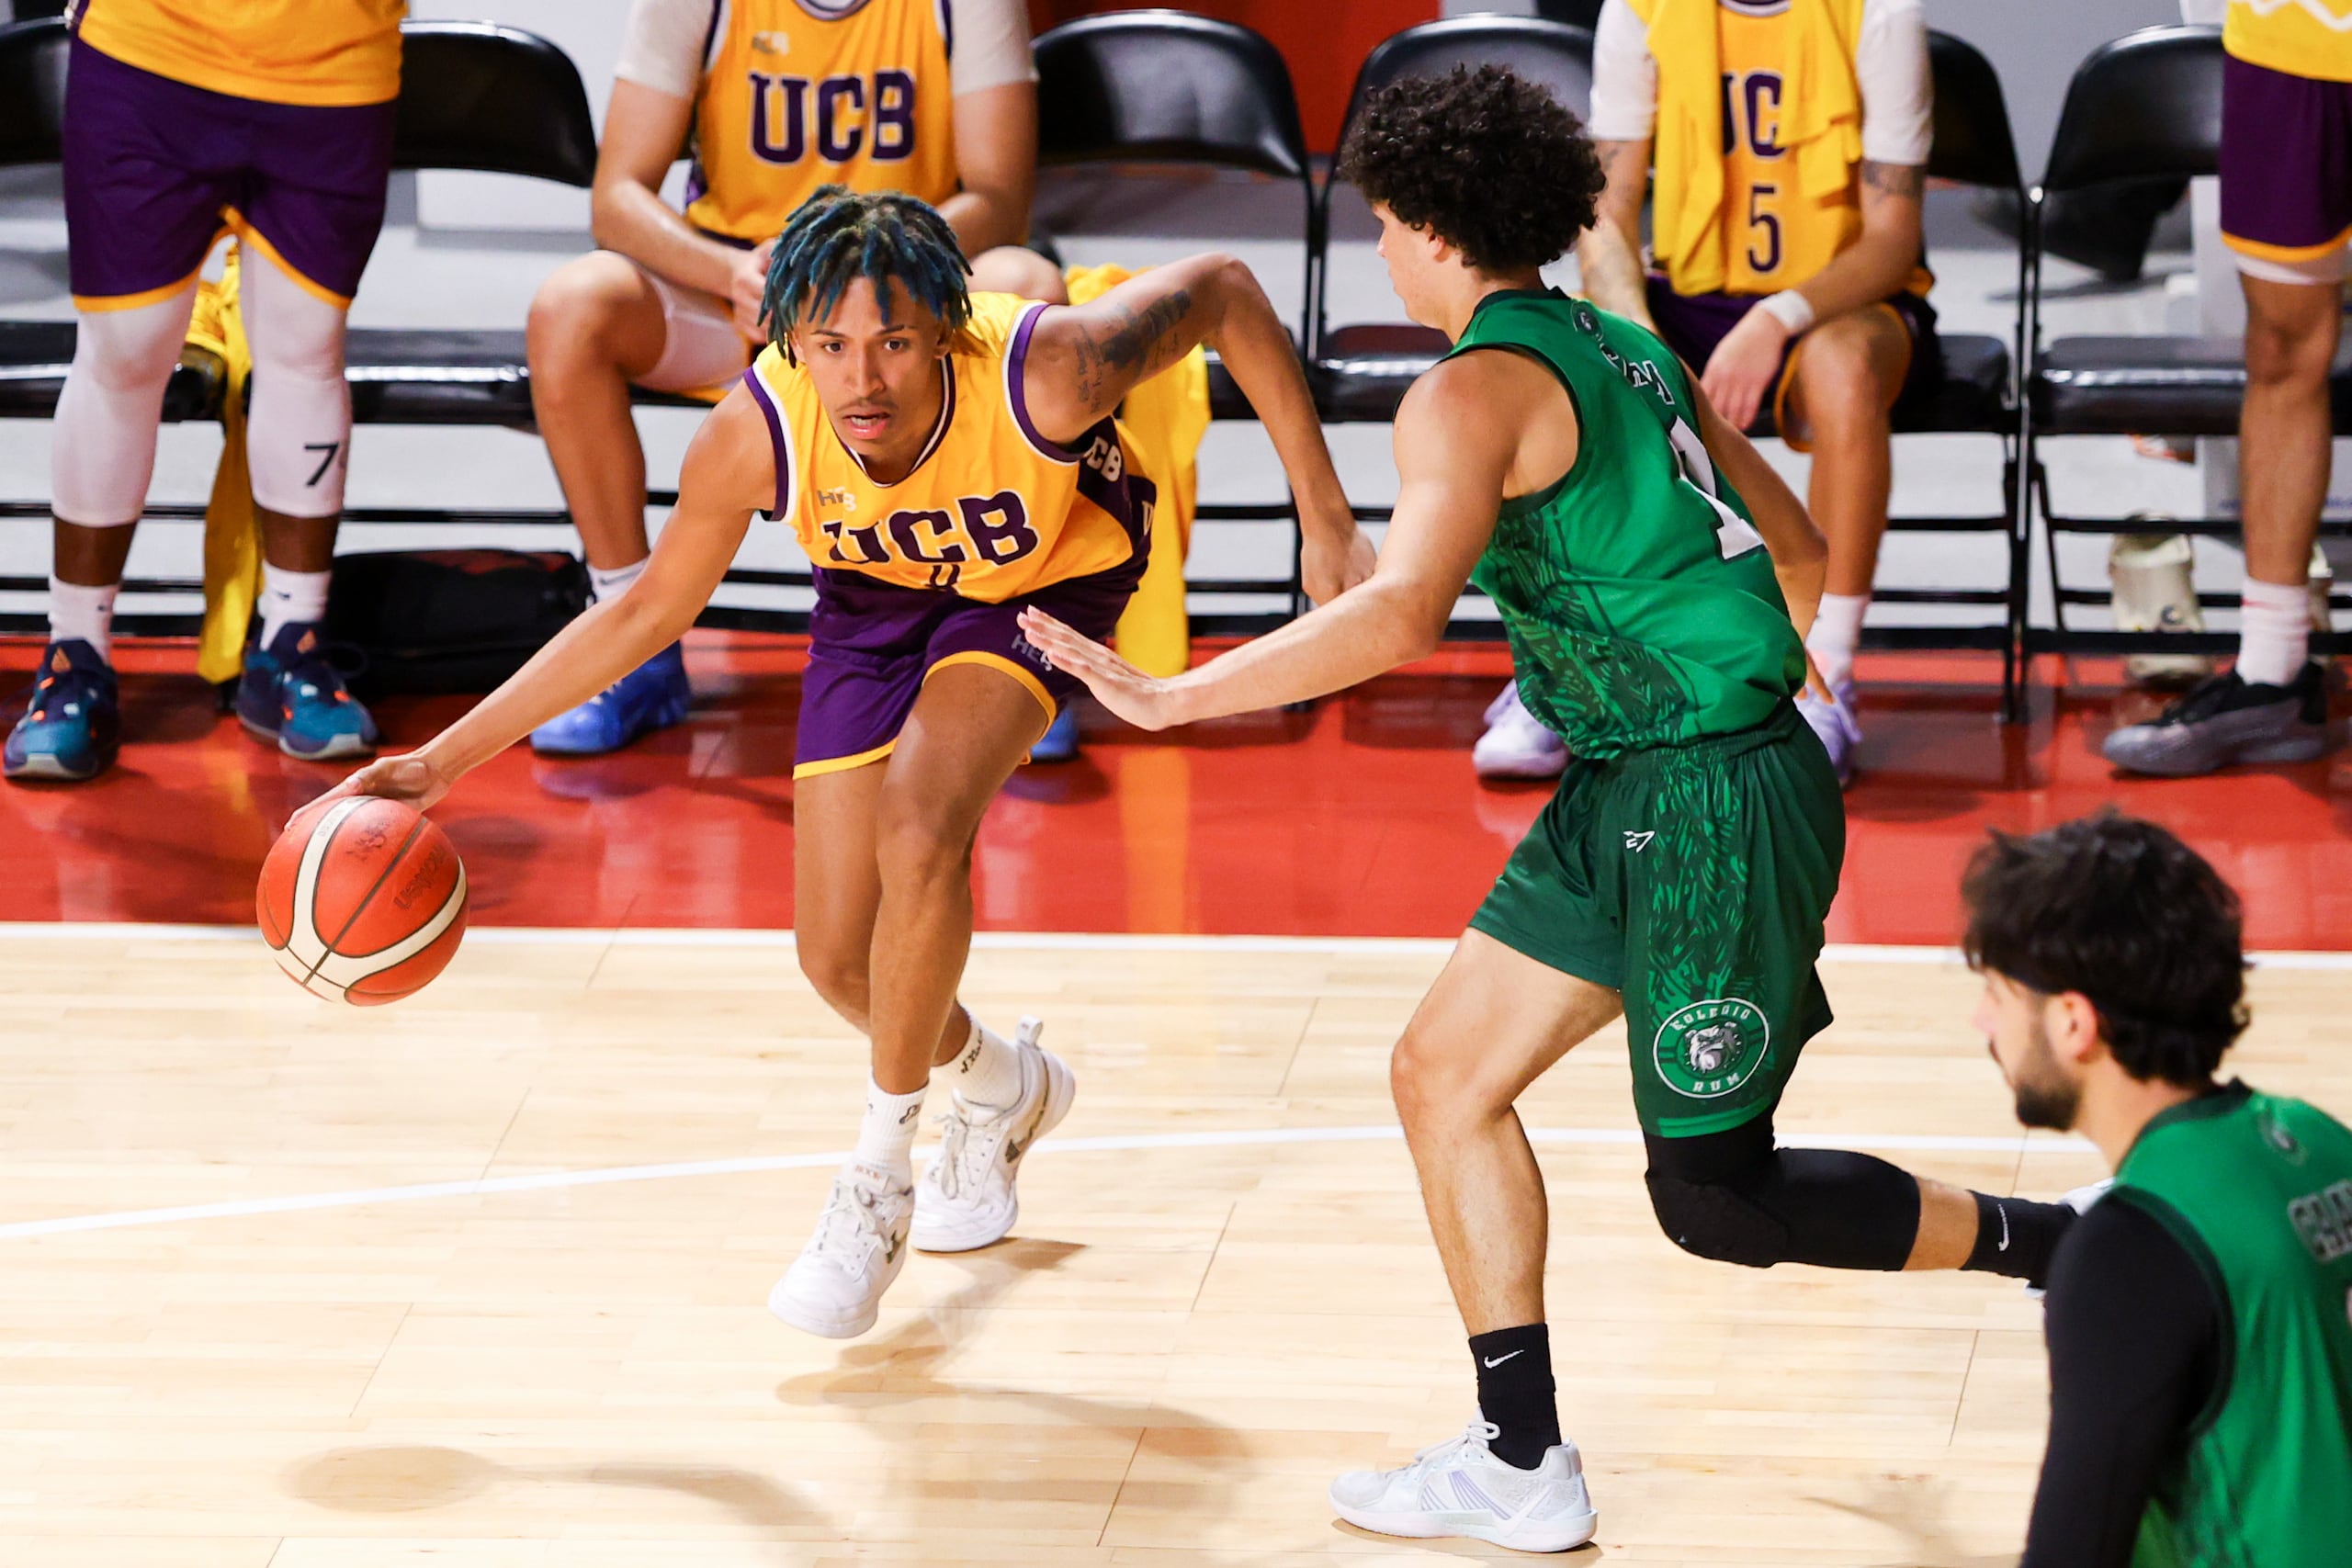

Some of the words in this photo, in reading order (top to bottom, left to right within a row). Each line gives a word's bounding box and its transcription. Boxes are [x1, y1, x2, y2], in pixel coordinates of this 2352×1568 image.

[748, 69, 915, 164] UCB
[1747, 184, 1781, 273] 5
[303, 443, 340, 487] 7
[821, 488, 1040, 568] UCB
[1668, 1005, 1751, 1031] COLEGIO
[1692, 1072, 1740, 1092] RUM
